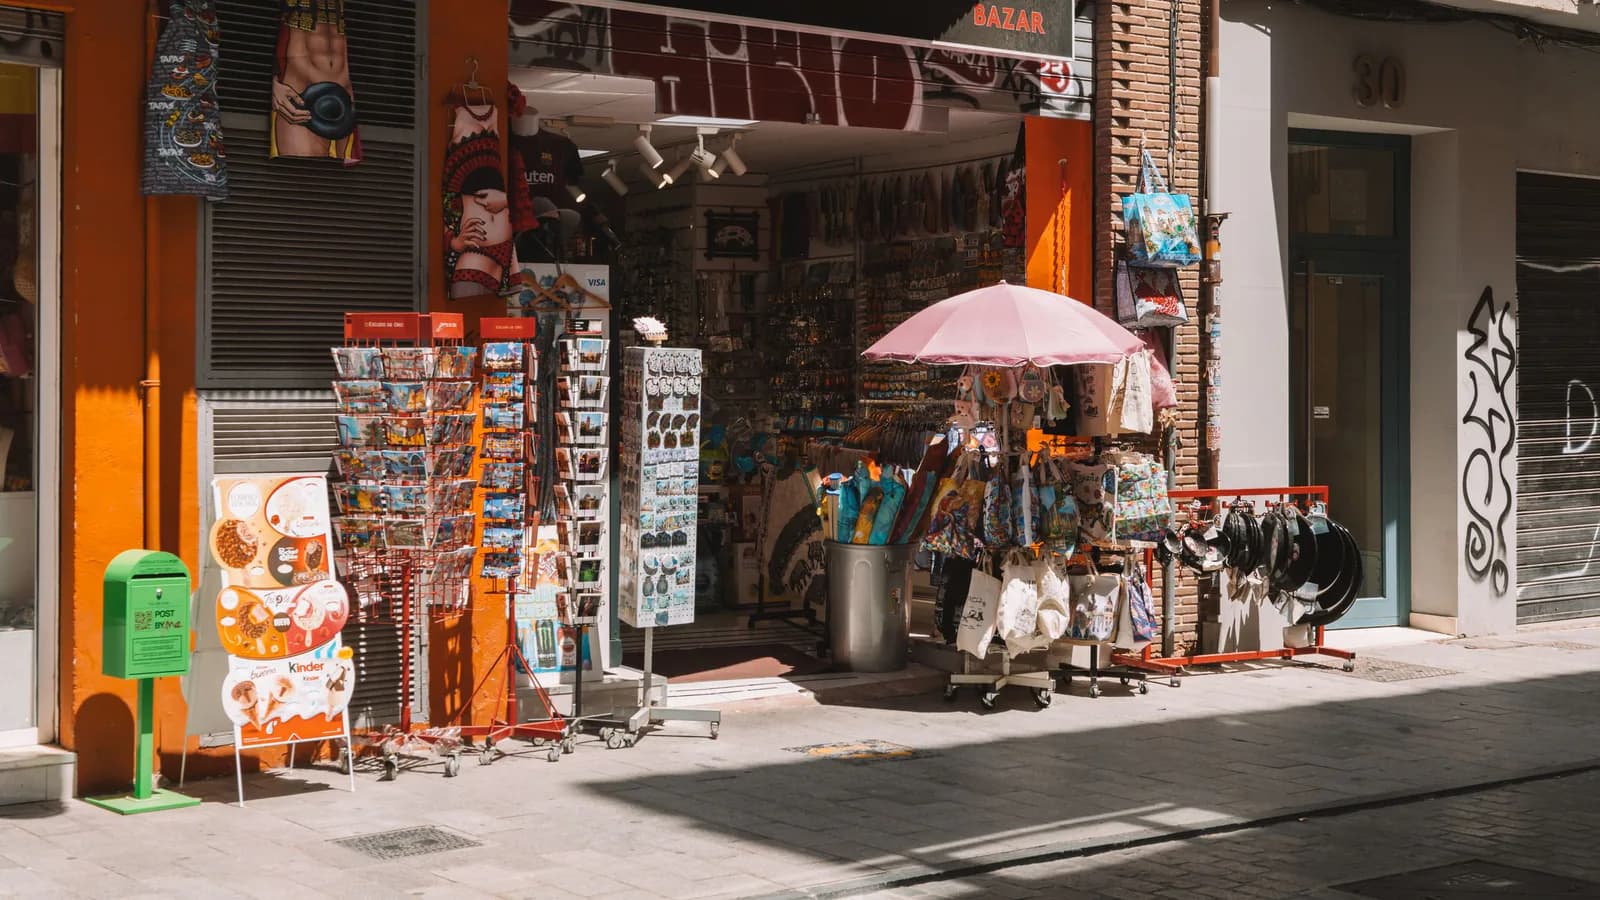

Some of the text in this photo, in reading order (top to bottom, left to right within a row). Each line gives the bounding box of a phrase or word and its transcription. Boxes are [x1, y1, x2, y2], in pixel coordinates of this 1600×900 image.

[973, 4, 1046, 35] BAZAR
[160, 55, 185, 63] TAPAS
[1352, 55, 1406, 110] 30
[149, 102, 174, 110] TAPAS
[158, 148, 183, 156] TAPAS
[524, 170, 554, 183] uten
[588, 278, 606, 286] VISA
[155, 610, 176, 618] POST
